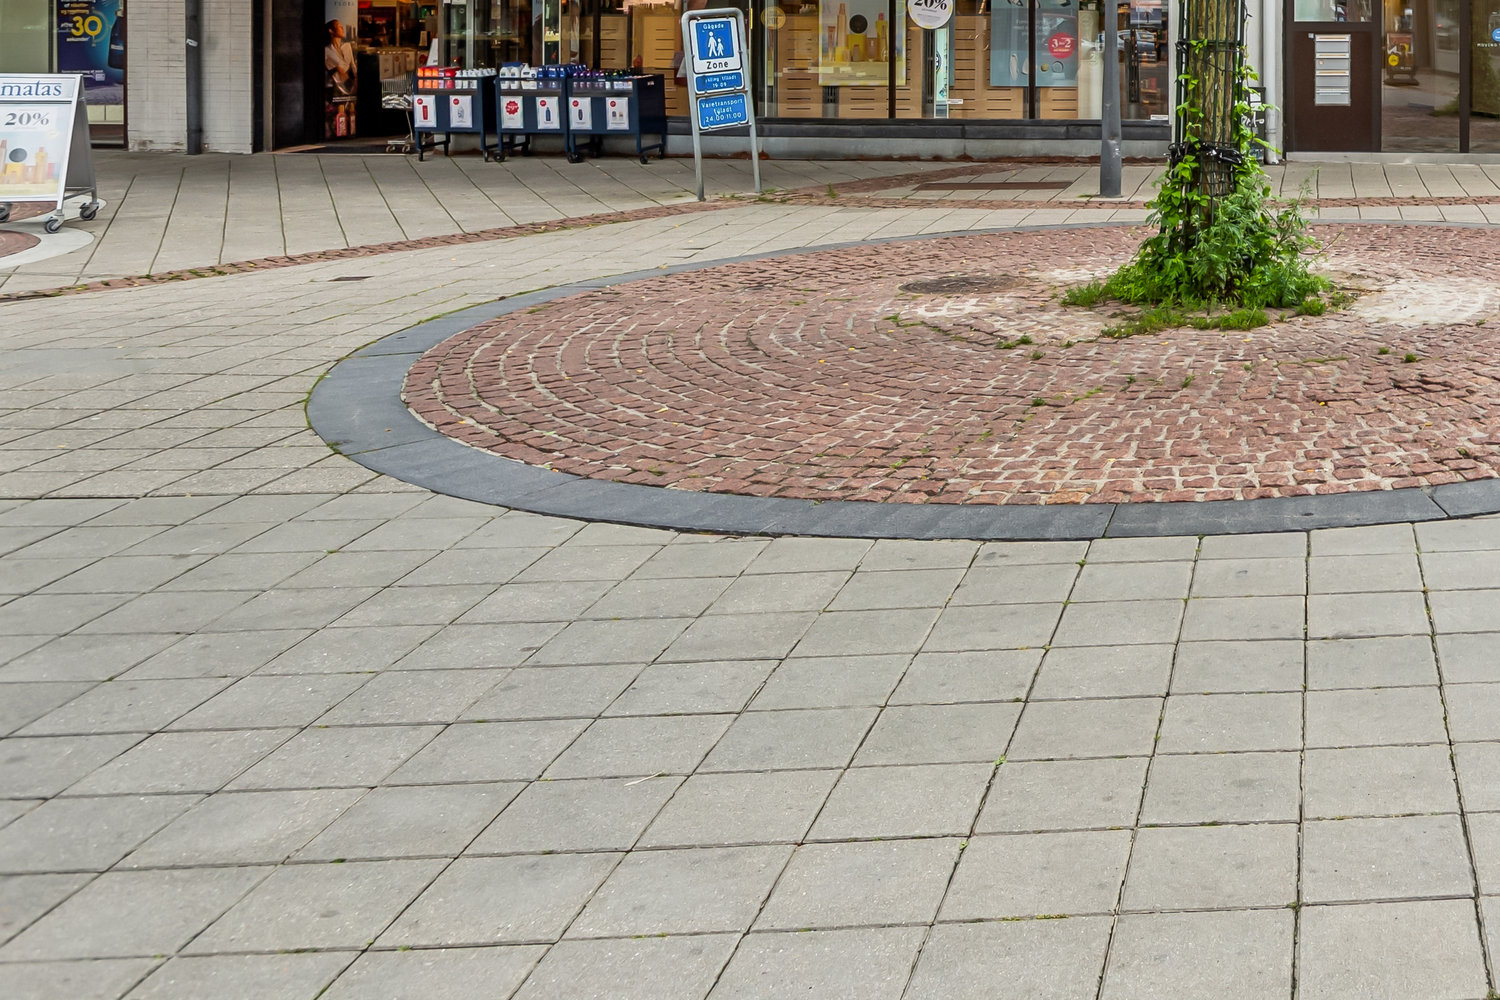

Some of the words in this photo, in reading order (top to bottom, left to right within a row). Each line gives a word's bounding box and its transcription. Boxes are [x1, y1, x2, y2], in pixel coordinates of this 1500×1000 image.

[71, 15, 103, 36] 30
[1051, 38, 1059, 48] 3
[1064, 38, 1071, 48] 2
[706, 61, 729, 70] Zone
[0, 80, 62, 96] matas
[701, 98, 743, 109] Varetransport
[4, 111, 50, 126] 20%
